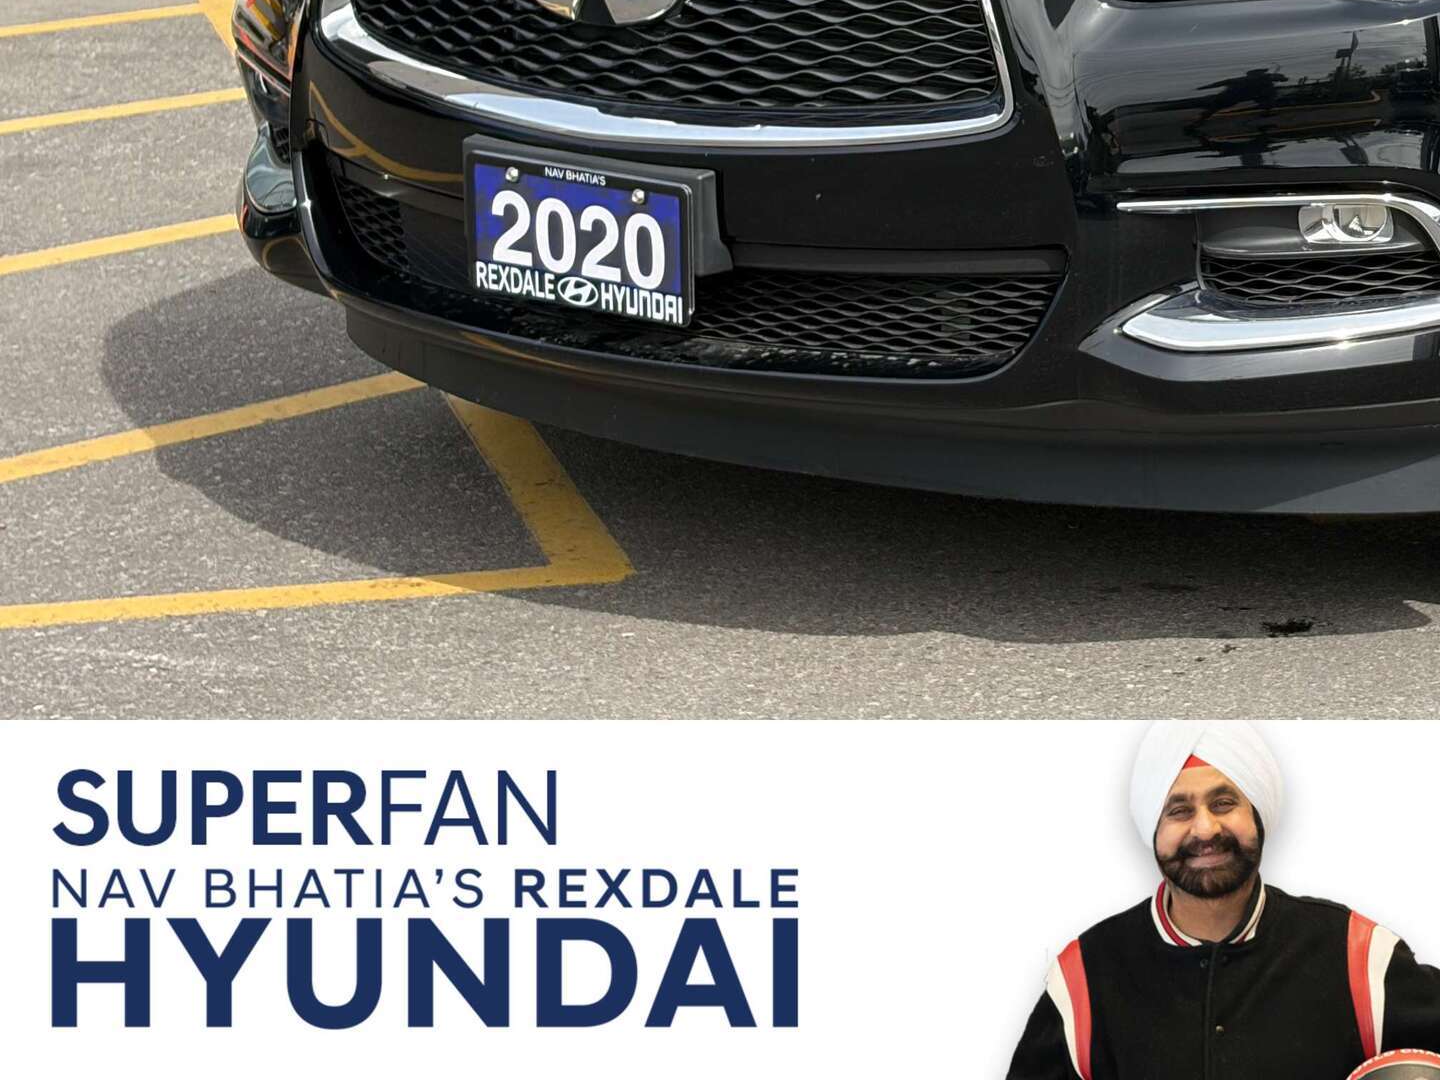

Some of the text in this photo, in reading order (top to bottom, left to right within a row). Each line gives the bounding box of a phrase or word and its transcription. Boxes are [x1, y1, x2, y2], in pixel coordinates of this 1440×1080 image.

[545, 166, 606, 186] NAV BHATIA'S
[491, 190, 666, 290] 2020
[475, 261, 684, 324] REXDALE HYUNDAI
